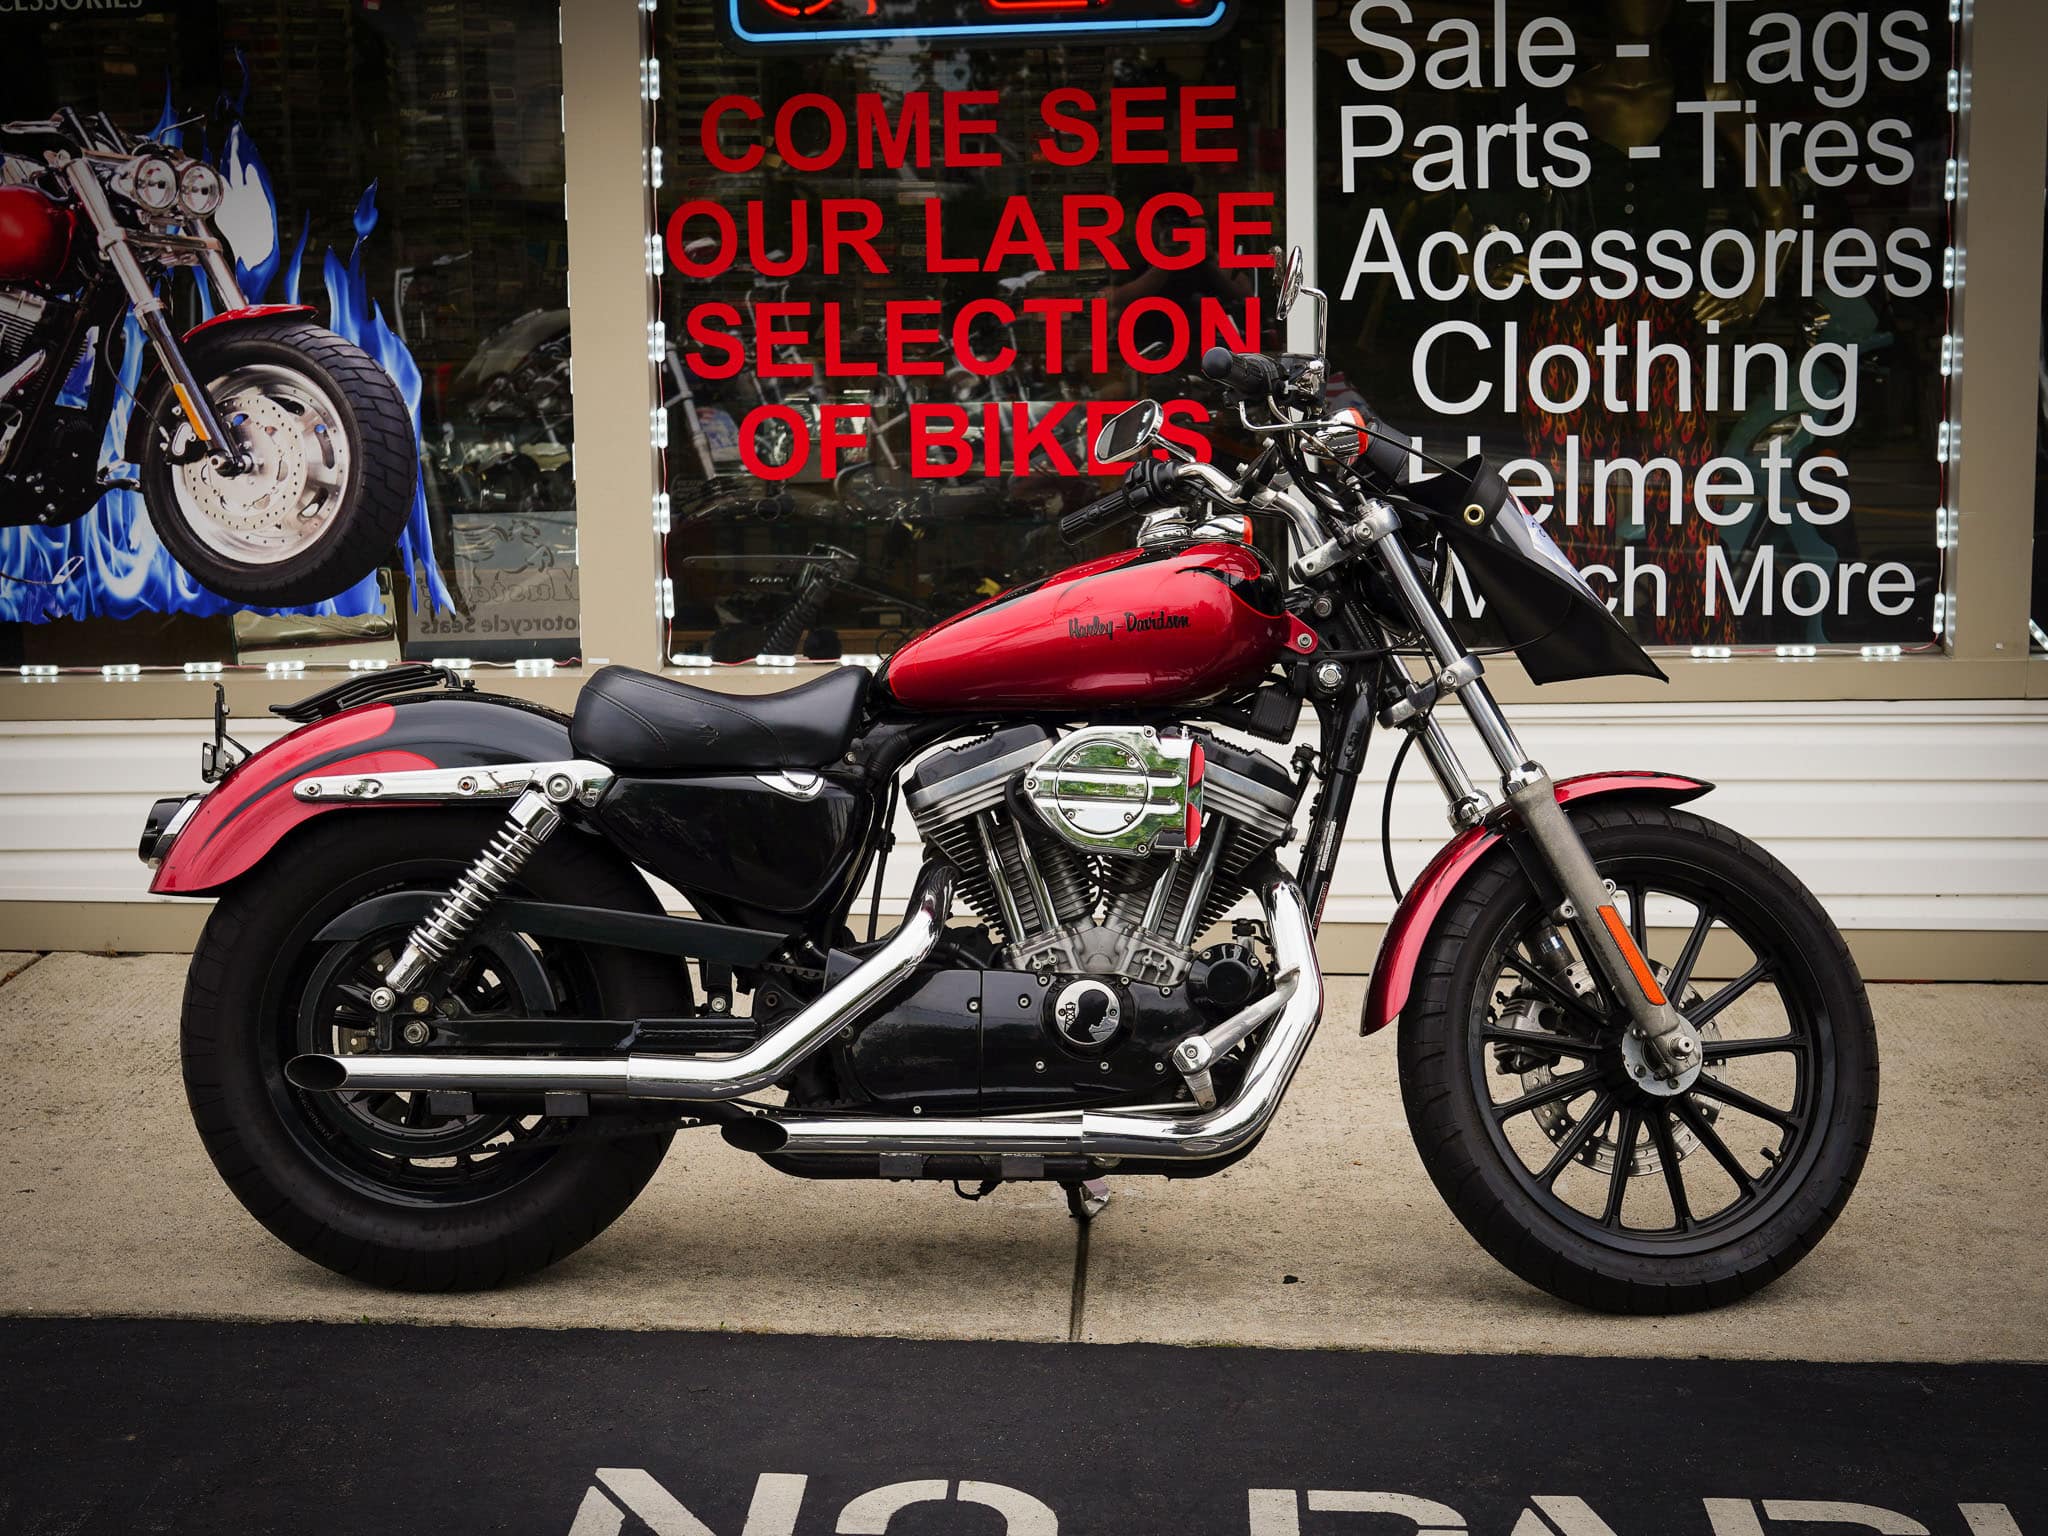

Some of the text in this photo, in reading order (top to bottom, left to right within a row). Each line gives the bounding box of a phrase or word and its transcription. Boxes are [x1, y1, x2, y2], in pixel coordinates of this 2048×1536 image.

[1346, 0, 1576, 91] Sale
[1686, 0, 1931, 108] Tags
[701, 86, 1238, 173] COME SEE
[1340, 102, 1592, 193] Parts
[1676, 100, 1914, 189] Tires
[666, 191, 1277, 279] OUR LARGE
[1339, 205, 1932, 301] Accessories
[685, 296, 1261, 380] SELECTION
[1412, 320, 1858, 437] Clothing
[737, 396, 1213, 482] OF BIKES
[1440, 544, 1916, 618] ch More
